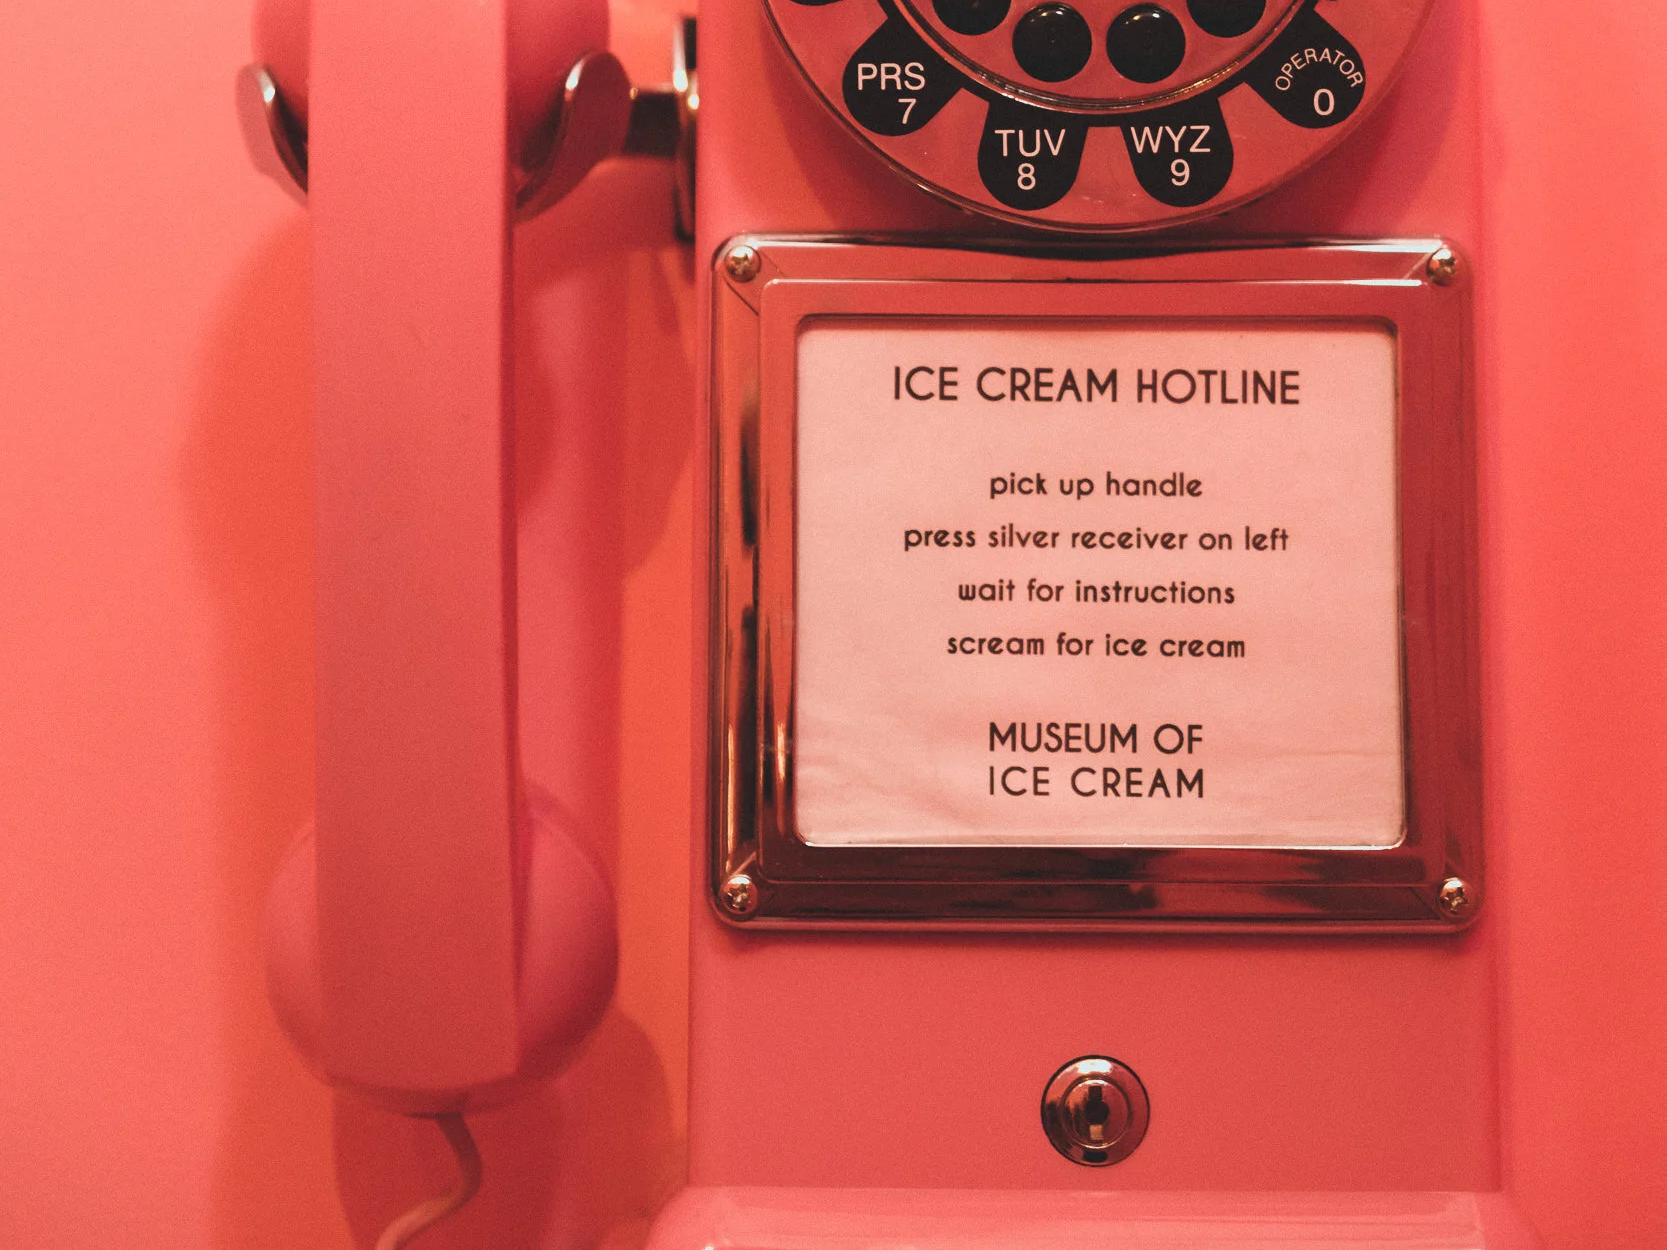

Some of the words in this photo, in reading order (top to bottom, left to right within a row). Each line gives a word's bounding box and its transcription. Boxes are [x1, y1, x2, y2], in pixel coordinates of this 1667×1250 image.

[857, 61, 926, 91] PRS
[1274, 47, 1365, 91] OPERATOR
[898, 98, 917, 125] 7
[994, 128, 1066, 157] TUV
[1130, 125, 1211, 154] WYZ
[1017, 162, 1036, 191] 8
[1170, 158, 1190, 187] 9
[894, 365, 959, 401] ICE
[976, 366, 1118, 403] CREAM
[1136, 368, 1300, 405] HOTLINE
[990, 472, 1048, 500] pick
[1059, 477, 1095, 501] up
[1106, 470, 1203, 498] handle
[904, 529, 976, 552] press
[988, 522, 1060, 549] silver
[1071, 527, 1189, 551] receiver
[1198, 532, 1233, 551] on
[1244, 525, 1289, 552] left
[958, 578, 1016, 602] wait
[1026, 577, 1065, 602] for
[1075, 579, 1235, 605] instructions
[947, 636, 1045, 656] scream
[1056, 631, 1094, 656] for
[1105, 633, 1148, 657] ice
[1159, 638, 1245, 658] cream
[989, 721, 1138, 754] MUSEUM
[1153, 723, 1203, 755] OF
[989, 765, 1050, 797] ICE
[1070, 766, 1204, 799] CREAM
